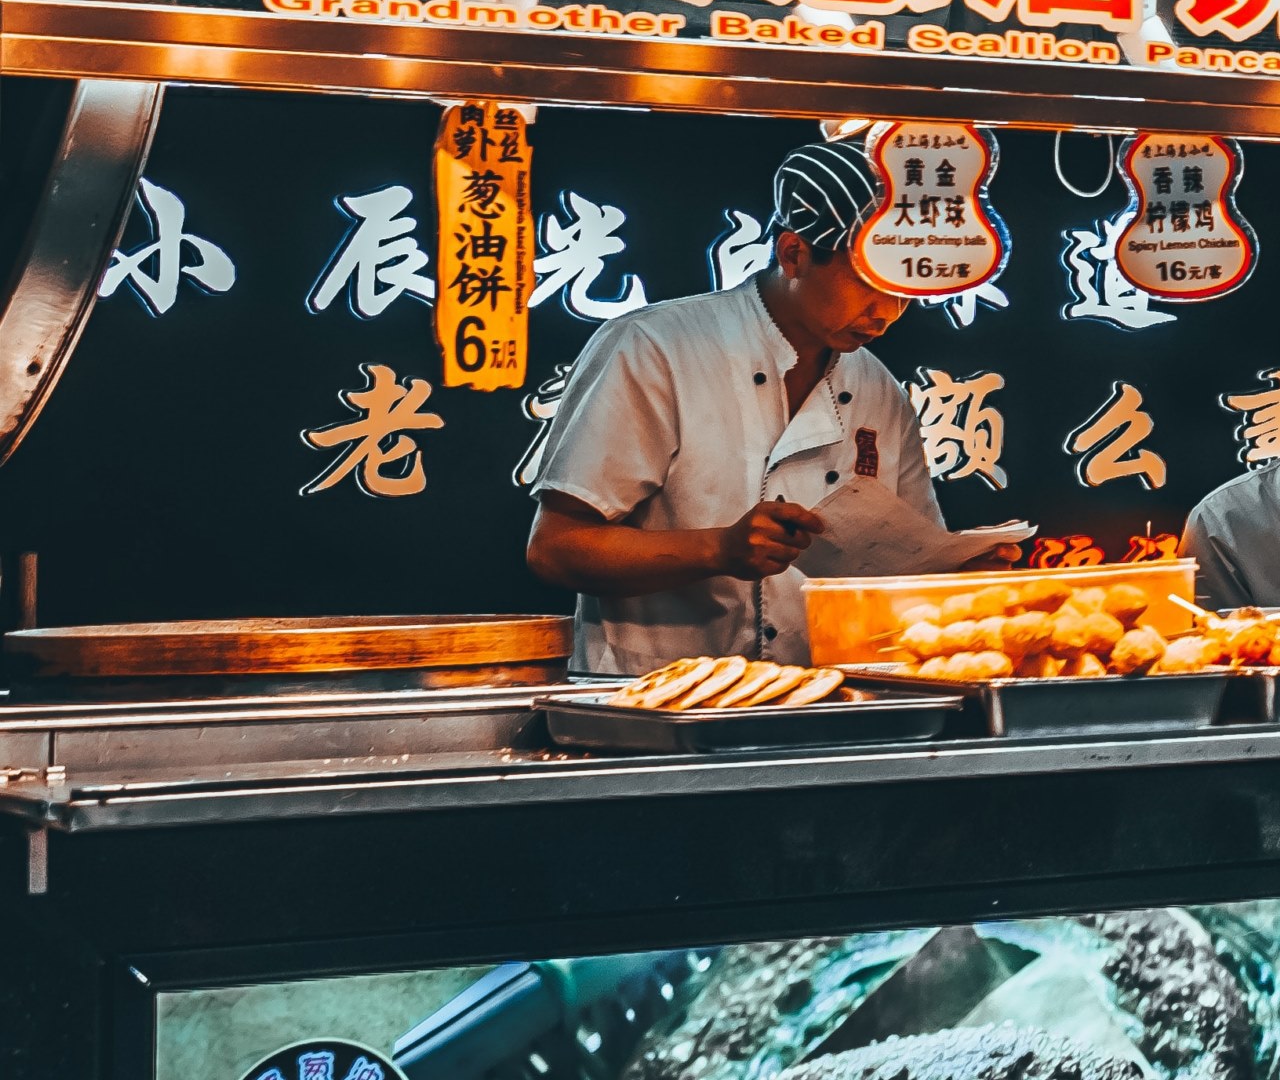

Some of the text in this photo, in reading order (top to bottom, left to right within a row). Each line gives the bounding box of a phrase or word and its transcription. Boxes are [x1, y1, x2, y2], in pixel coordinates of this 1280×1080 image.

[717, 14, 880, 49] Baked
[910, 26, 1119, 63] Scallion
[904, 158, 957, 187] 黄金
[1152, 166, 1205, 195] 香辣
[894, 194, 966, 228] 大虾球
[1146, 199, 1215, 234] 柠檬鸡
[448, 170, 513, 312] 葱油饼
[872, 234, 987, 248] Gold Large Shrimp balls
[1128, 237, 1241, 254] Spicy Lemon Chicken
[901, 257, 971, 278] 16元/客
[1155, 261, 1223, 282] 16元/客
